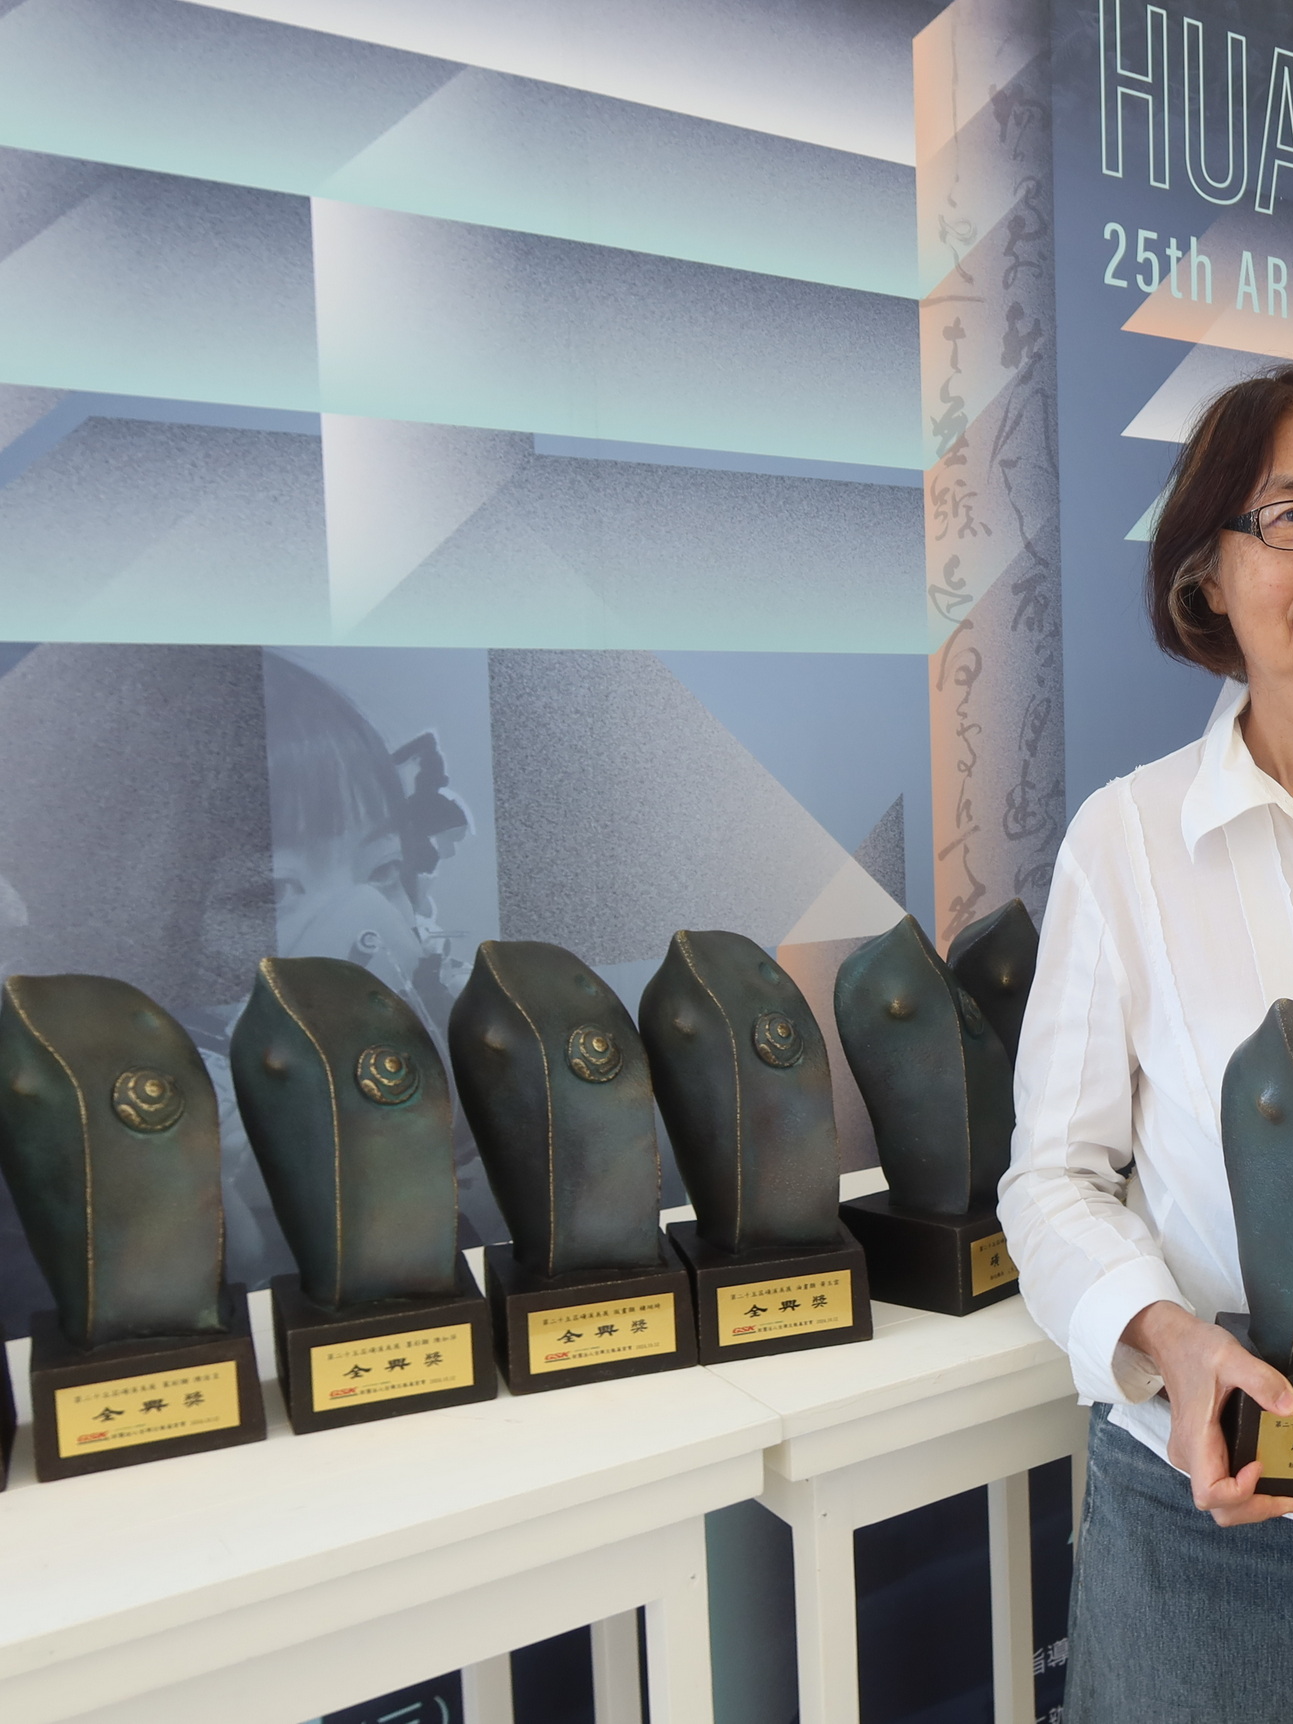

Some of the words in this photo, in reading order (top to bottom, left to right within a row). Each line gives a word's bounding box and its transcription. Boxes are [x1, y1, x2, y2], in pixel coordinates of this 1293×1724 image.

[1103, 221, 1213, 304] 25th
[744, 1294, 828, 1318] 全興獎
[557, 1319, 649, 1344] 全興獎
[343, 1351, 444, 1379] 全興獎
[92, 1391, 205, 1423] 全興獎
